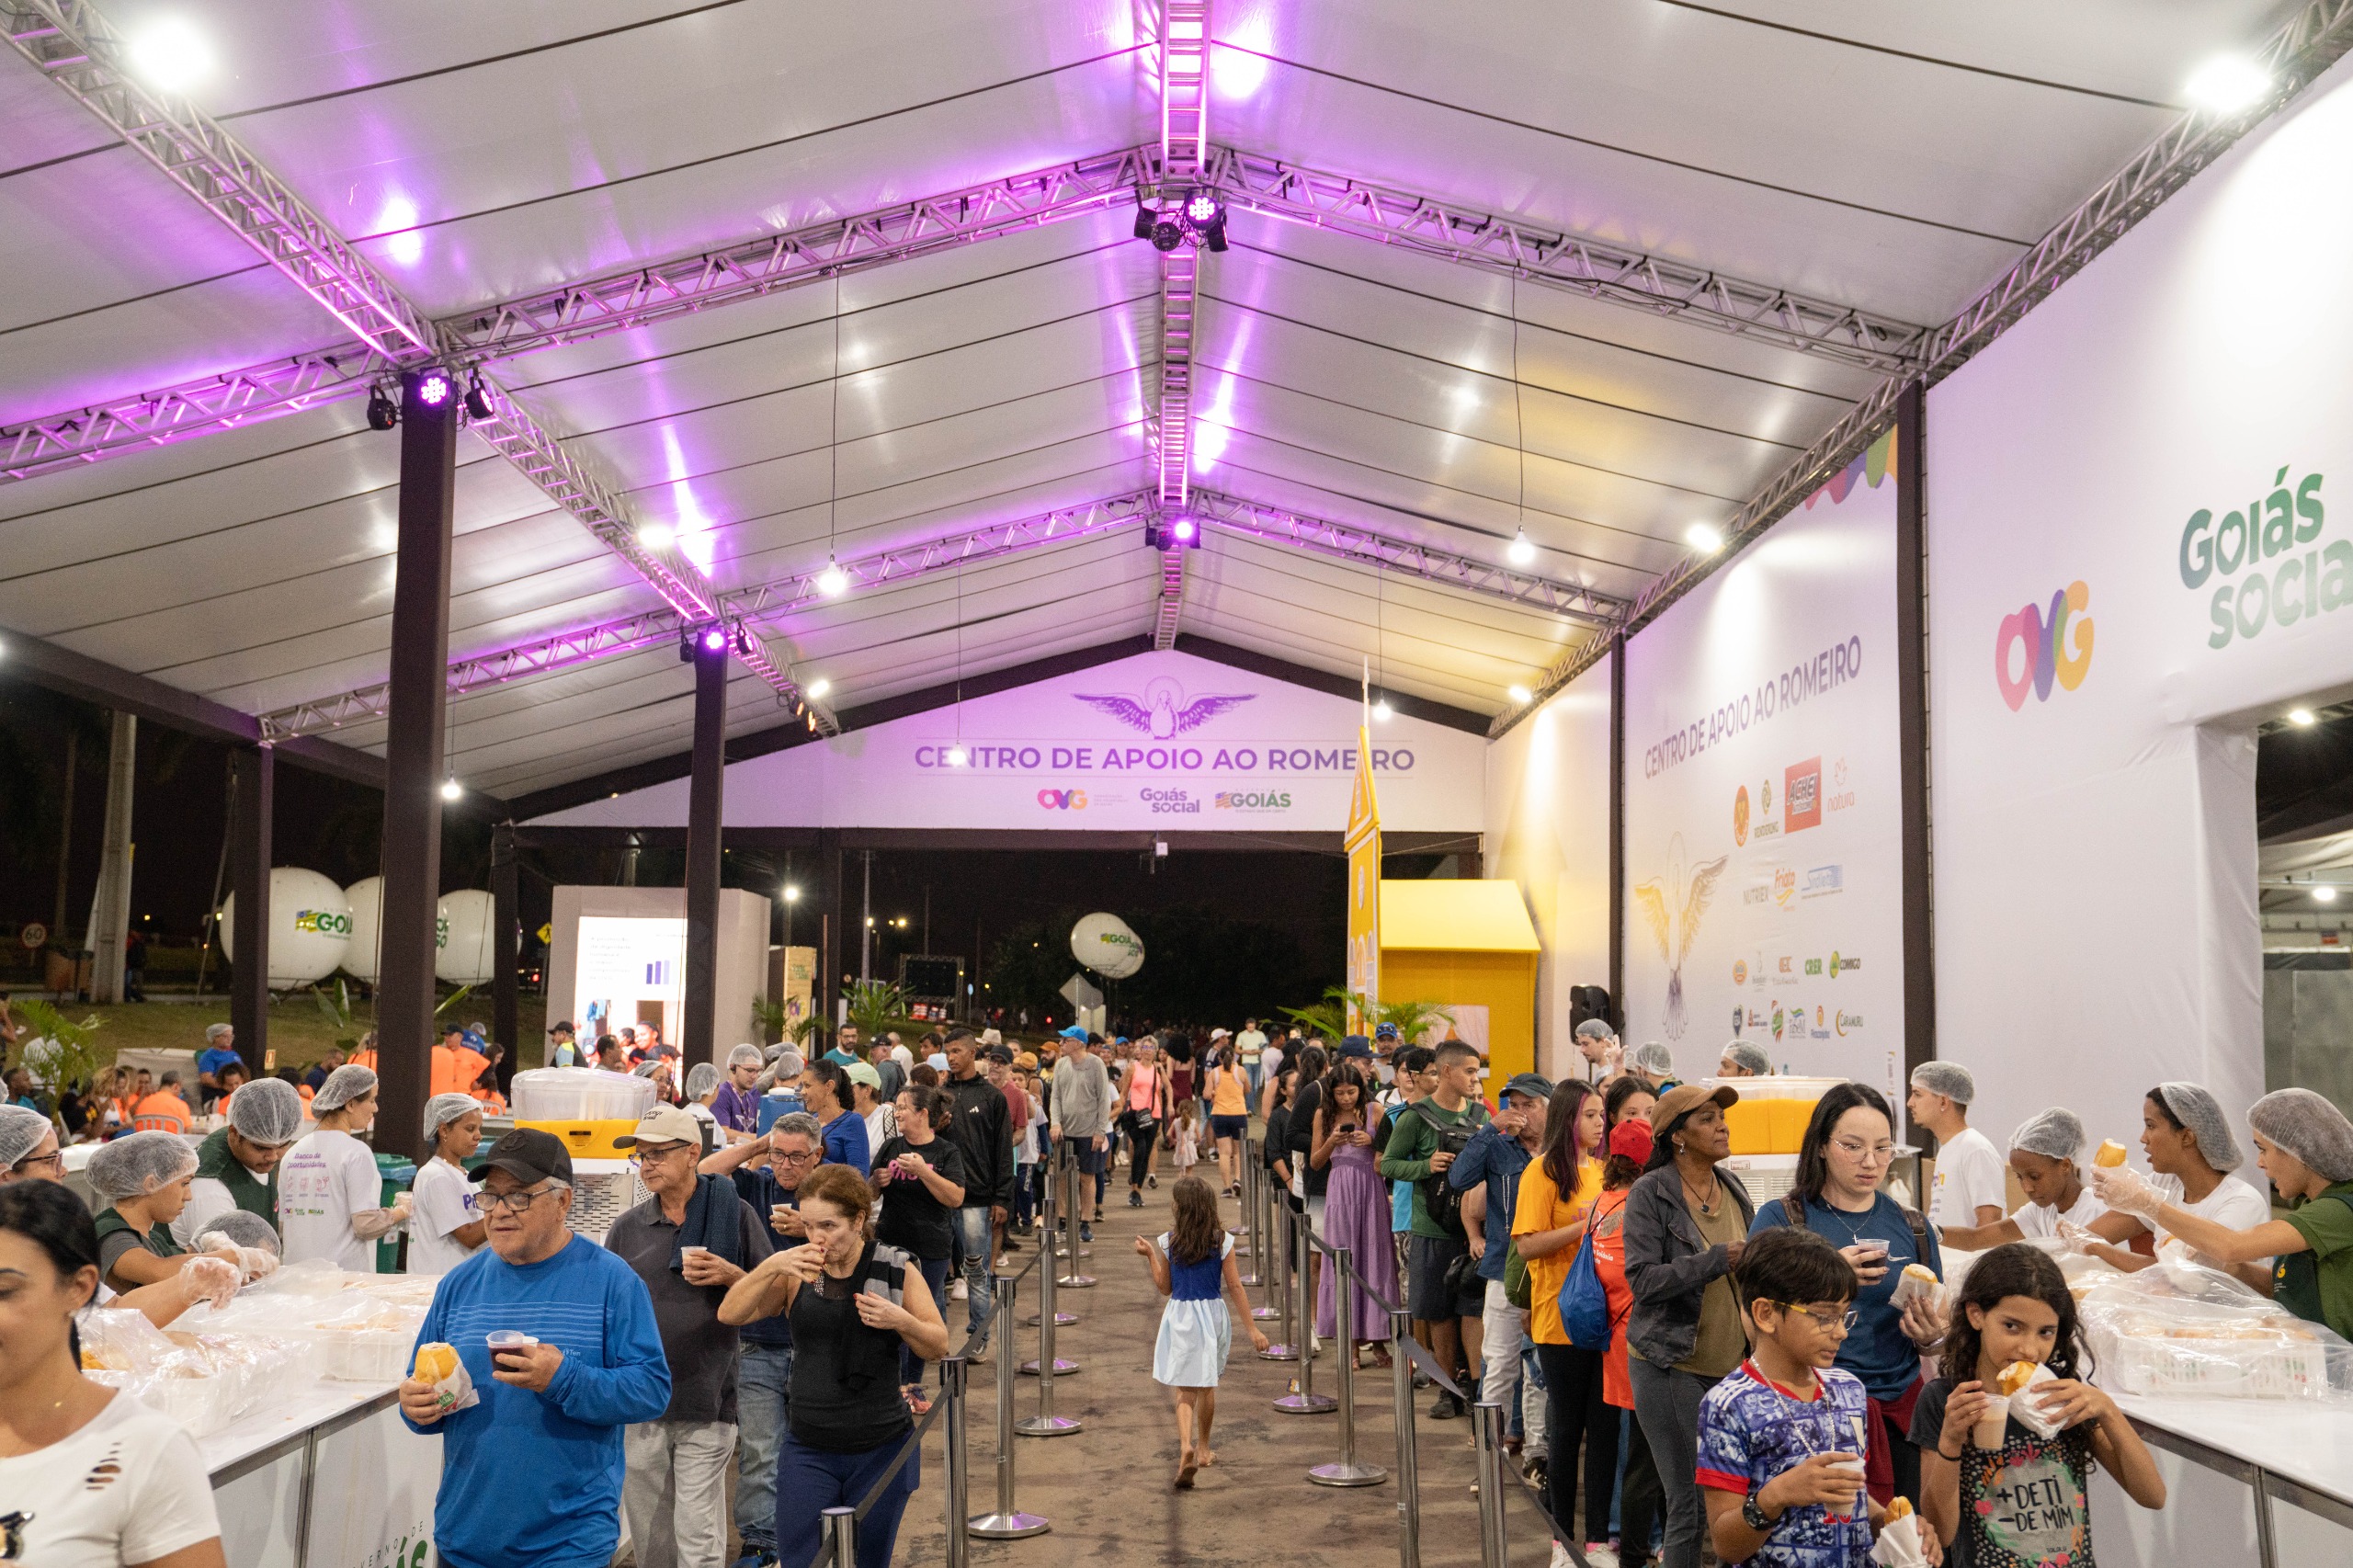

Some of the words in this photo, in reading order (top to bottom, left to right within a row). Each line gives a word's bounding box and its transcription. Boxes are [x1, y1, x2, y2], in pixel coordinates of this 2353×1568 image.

[2179, 464, 2325, 589] Goiás
[2207, 540, 2353, 649] socia
[1995, 580, 2094, 712] OVG
[1644, 729, 1687, 779] CENTRO
[1689, 718, 1706, 757] DE
[1708, 694, 1750, 748] APOIO
[1754, 680, 1776, 725] AO
[1780, 635, 1861, 712] ROMEIRO
[1051, 748, 1093, 769] DE
[1102, 748, 1203, 770] APOIO
[1212, 749, 1257, 770] AO
[1268, 749, 1415, 771] ROMERO
[1037, 789, 1088, 810] OVG
[1140, 788, 1188, 802] Goiás
[1231, 790, 1291, 808] GOIÁS
[1152, 800, 1200, 813] social
[26, 928, 42, 939] 60
